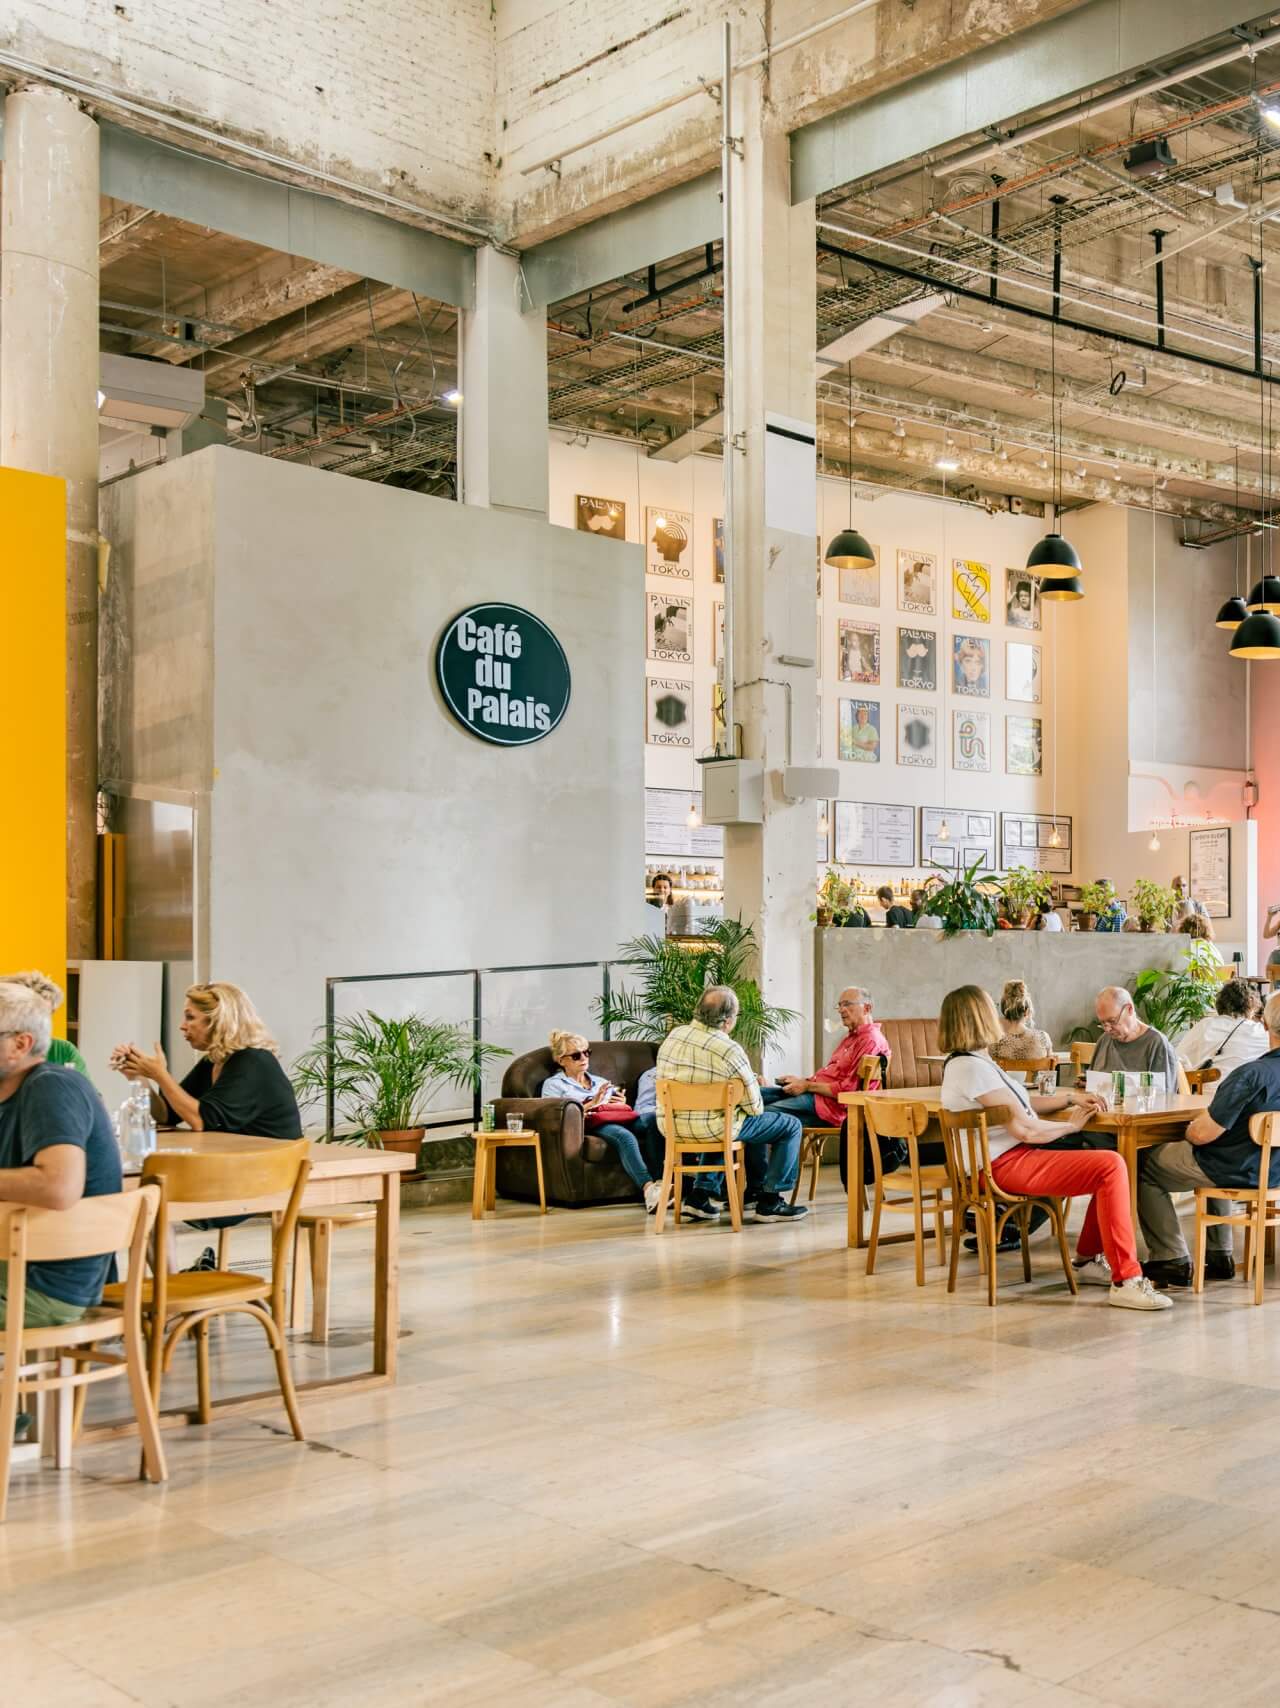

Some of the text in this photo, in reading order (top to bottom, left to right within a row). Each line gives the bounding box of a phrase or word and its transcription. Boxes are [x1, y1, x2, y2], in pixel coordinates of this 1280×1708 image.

[580, 497, 624, 513] PALAIS
[652, 564, 690, 578] TOKYO
[650, 595, 691, 607] PALAIS
[902, 601, 934, 613] TOKYO
[456, 616, 522, 658] Café
[900, 629, 934, 640] PALAIS
[652, 649, 691, 662] TOKYO
[475, 654, 511, 690] du
[650, 680, 691, 691] PALAIS
[902, 679, 934, 689] TOKYO
[468, 687, 551, 731] Palais
[900, 705, 934, 716] PALAIS
[652, 734, 691, 745] TOKYO
[902, 755, 934, 765] TOKYO
